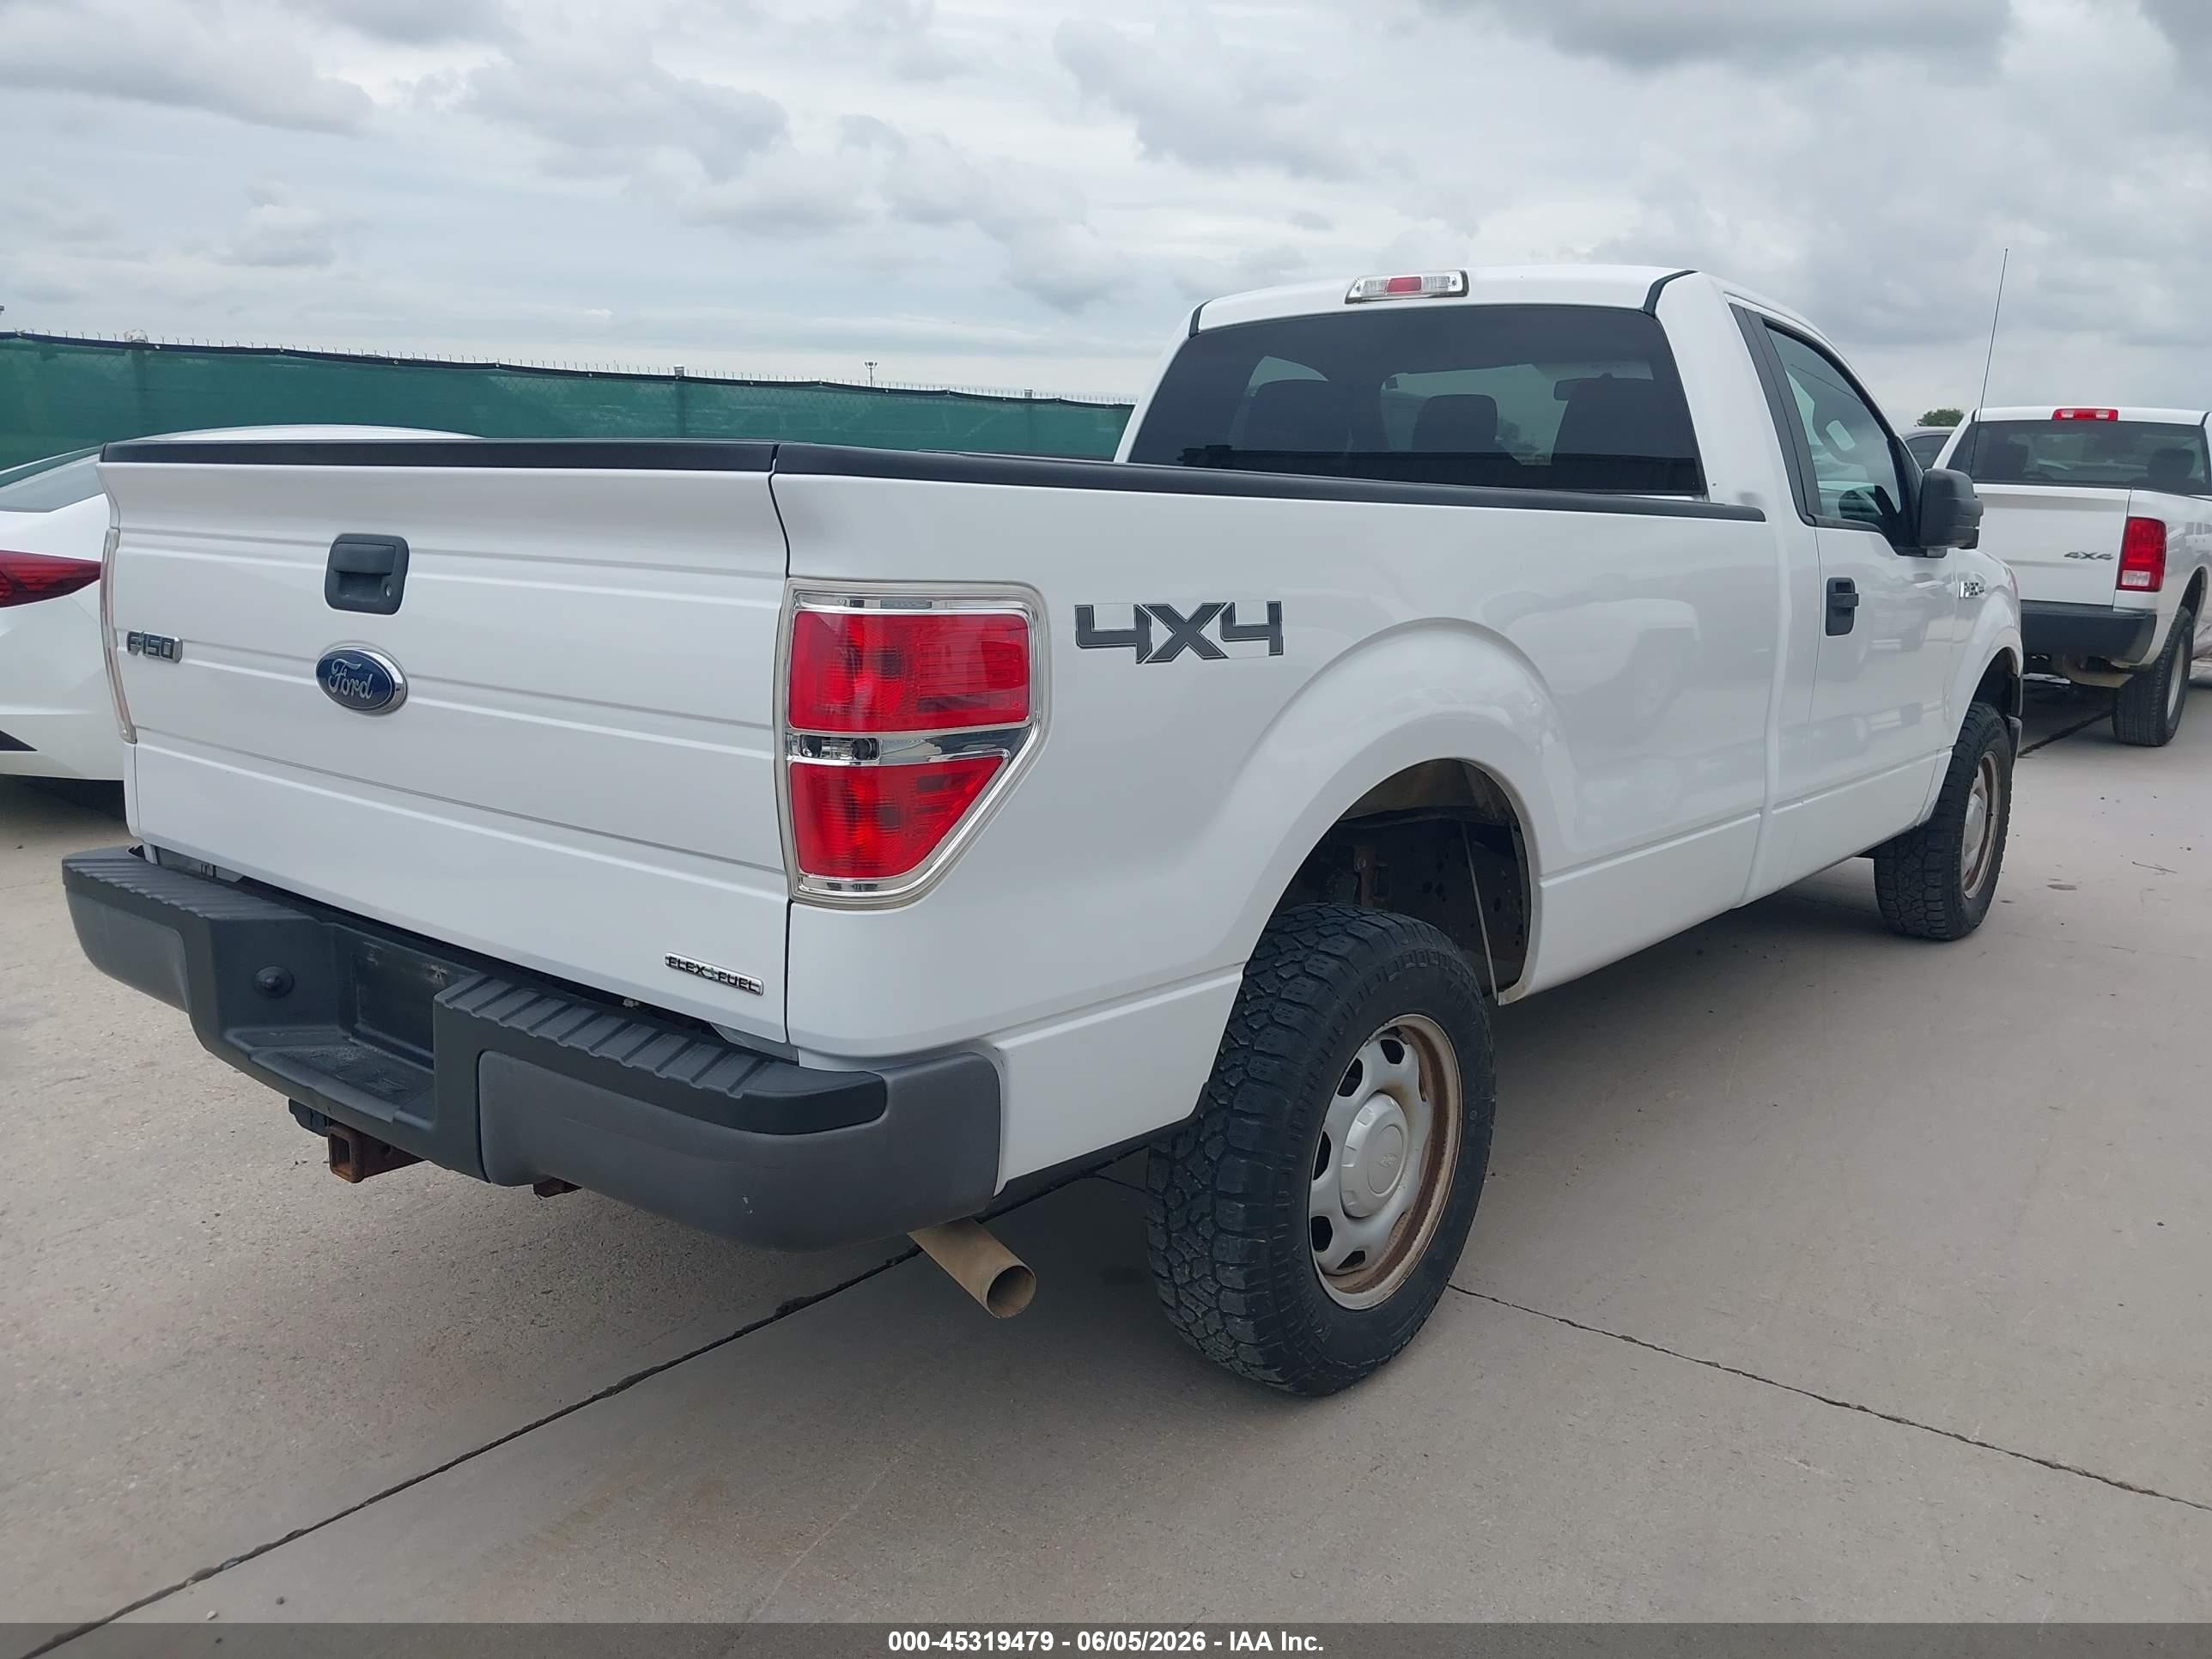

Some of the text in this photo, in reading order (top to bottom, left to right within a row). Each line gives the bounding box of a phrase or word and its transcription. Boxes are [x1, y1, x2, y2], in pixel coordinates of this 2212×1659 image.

[1074, 601, 1284, 664] 4X4
[328, 658, 373, 699] Ford
[668, 956, 761, 993] FLEX FUEL
